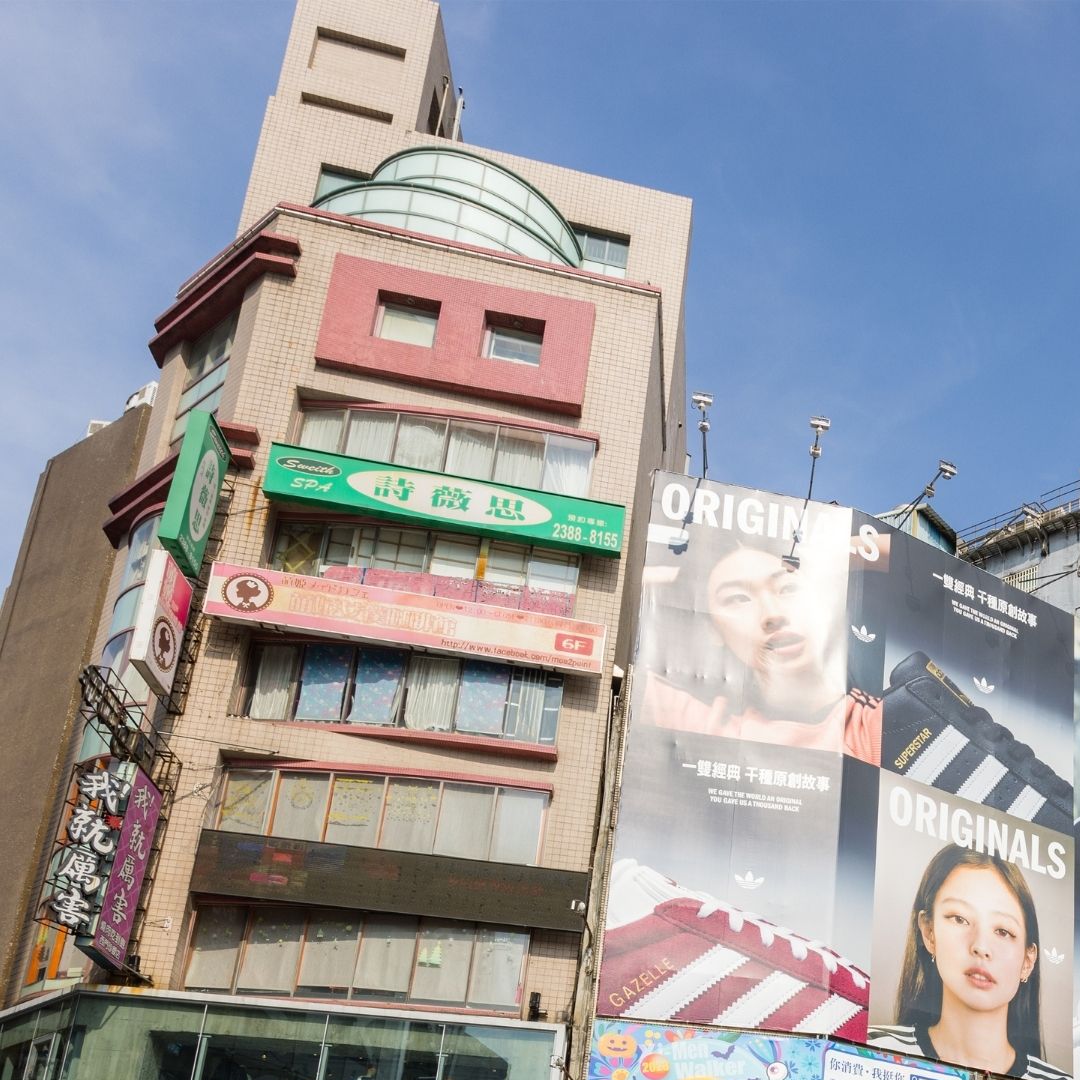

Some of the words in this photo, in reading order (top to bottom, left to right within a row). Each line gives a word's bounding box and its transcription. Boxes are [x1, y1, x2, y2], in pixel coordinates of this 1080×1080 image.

[290, 477, 332, 493] SPA
[374, 475, 526, 521] 詩薇思
[552, 522, 618, 548] 2388-8155
[661, 482, 880, 562] ORIGINS
[933, 573, 974, 600] 一雙經典
[977, 589, 1037, 626] 千種原創故事
[561, 638, 586, 651] 6F
[894, 728, 933, 769] SUPERSTAR
[682, 760, 740, 781] 一雙經典
[745, 767, 830, 791] 千種原創故事
[889, 786, 1066, 879] ORIGINALS
[608, 957, 675, 1008] GAZELLE
